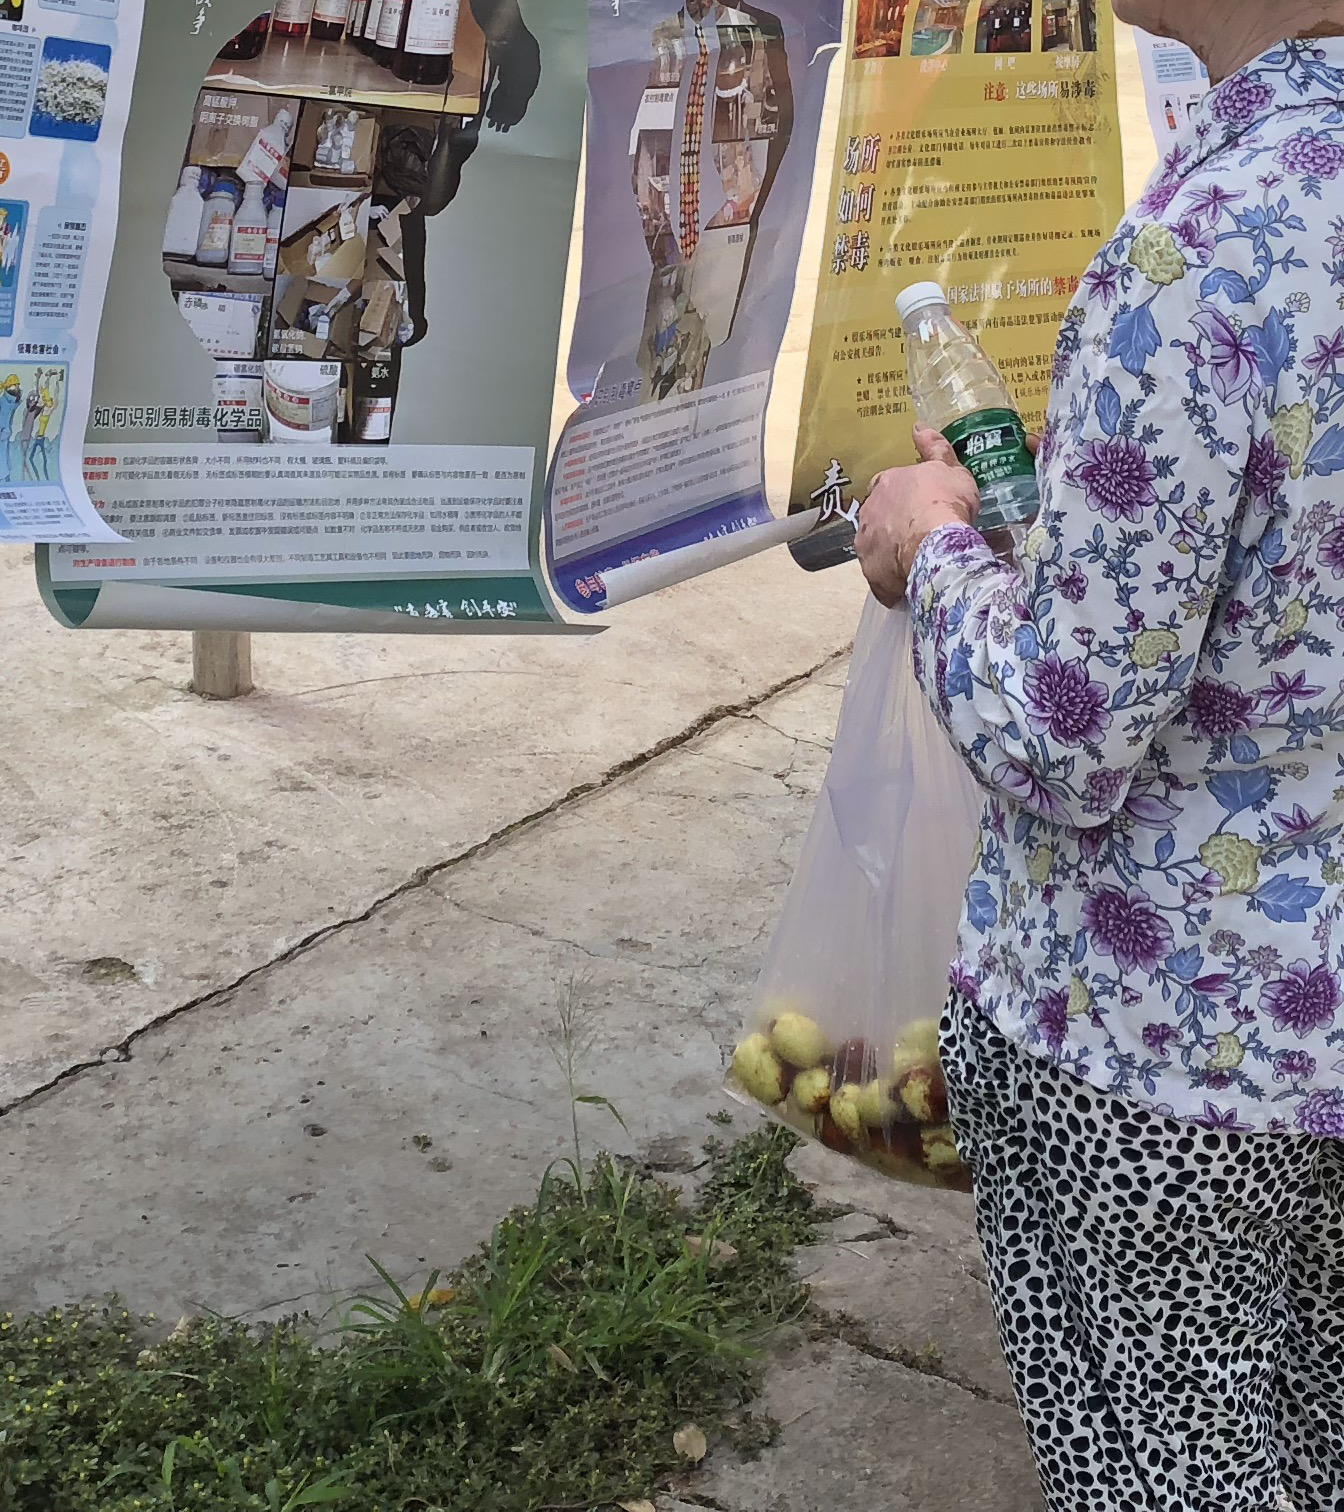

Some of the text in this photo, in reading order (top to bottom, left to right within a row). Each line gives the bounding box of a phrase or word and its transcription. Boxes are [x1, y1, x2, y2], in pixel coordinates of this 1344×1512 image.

[93, 406, 263, 430] 如何识别易制毒化学品
